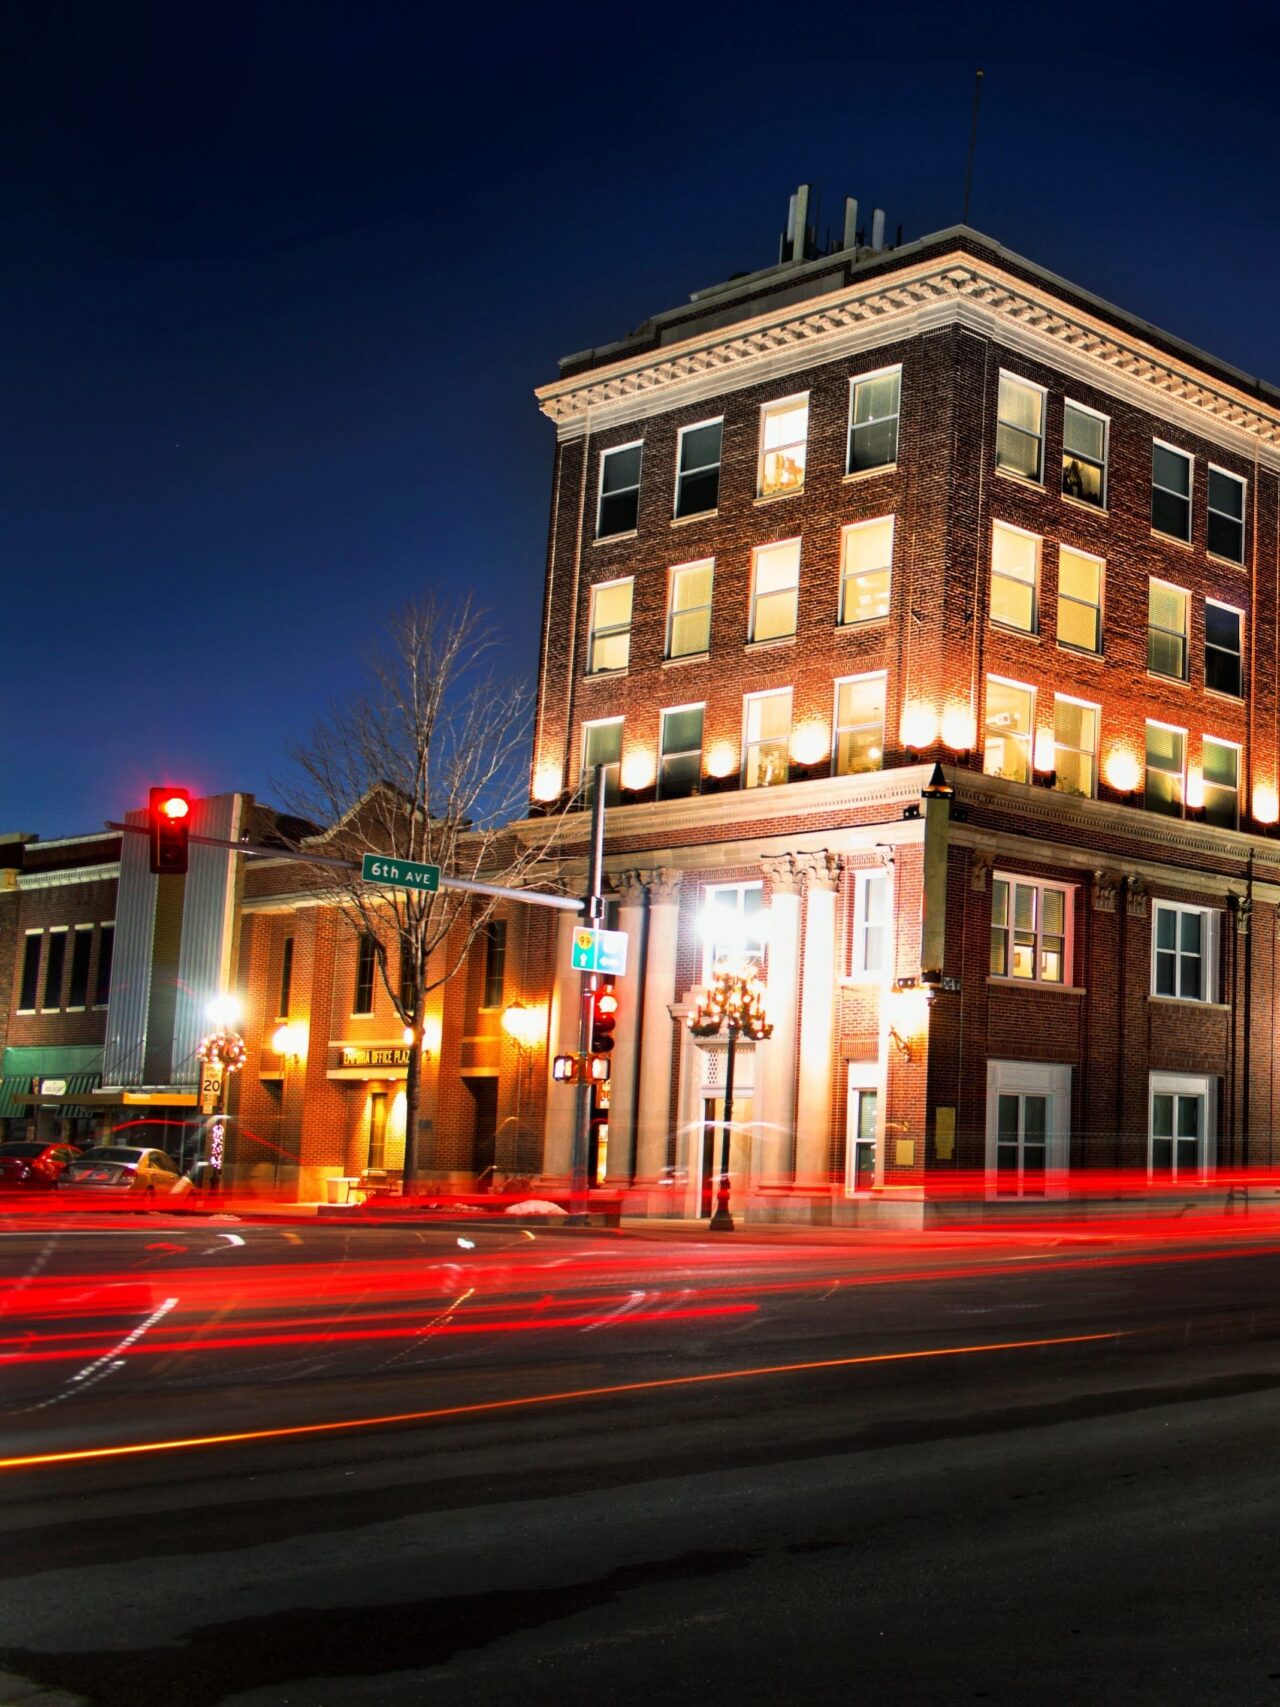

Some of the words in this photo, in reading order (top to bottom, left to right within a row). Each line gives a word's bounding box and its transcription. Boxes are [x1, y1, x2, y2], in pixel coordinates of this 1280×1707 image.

[371, 862, 399, 879] 6th
[405, 871, 431, 885] AVE
[580, 935, 591, 947] 99
[371, 1050, 393, 1064] OFFICE
[394, 1050, 410, 1063] PLAZ
[203, 1079, 220, 1092] 20
